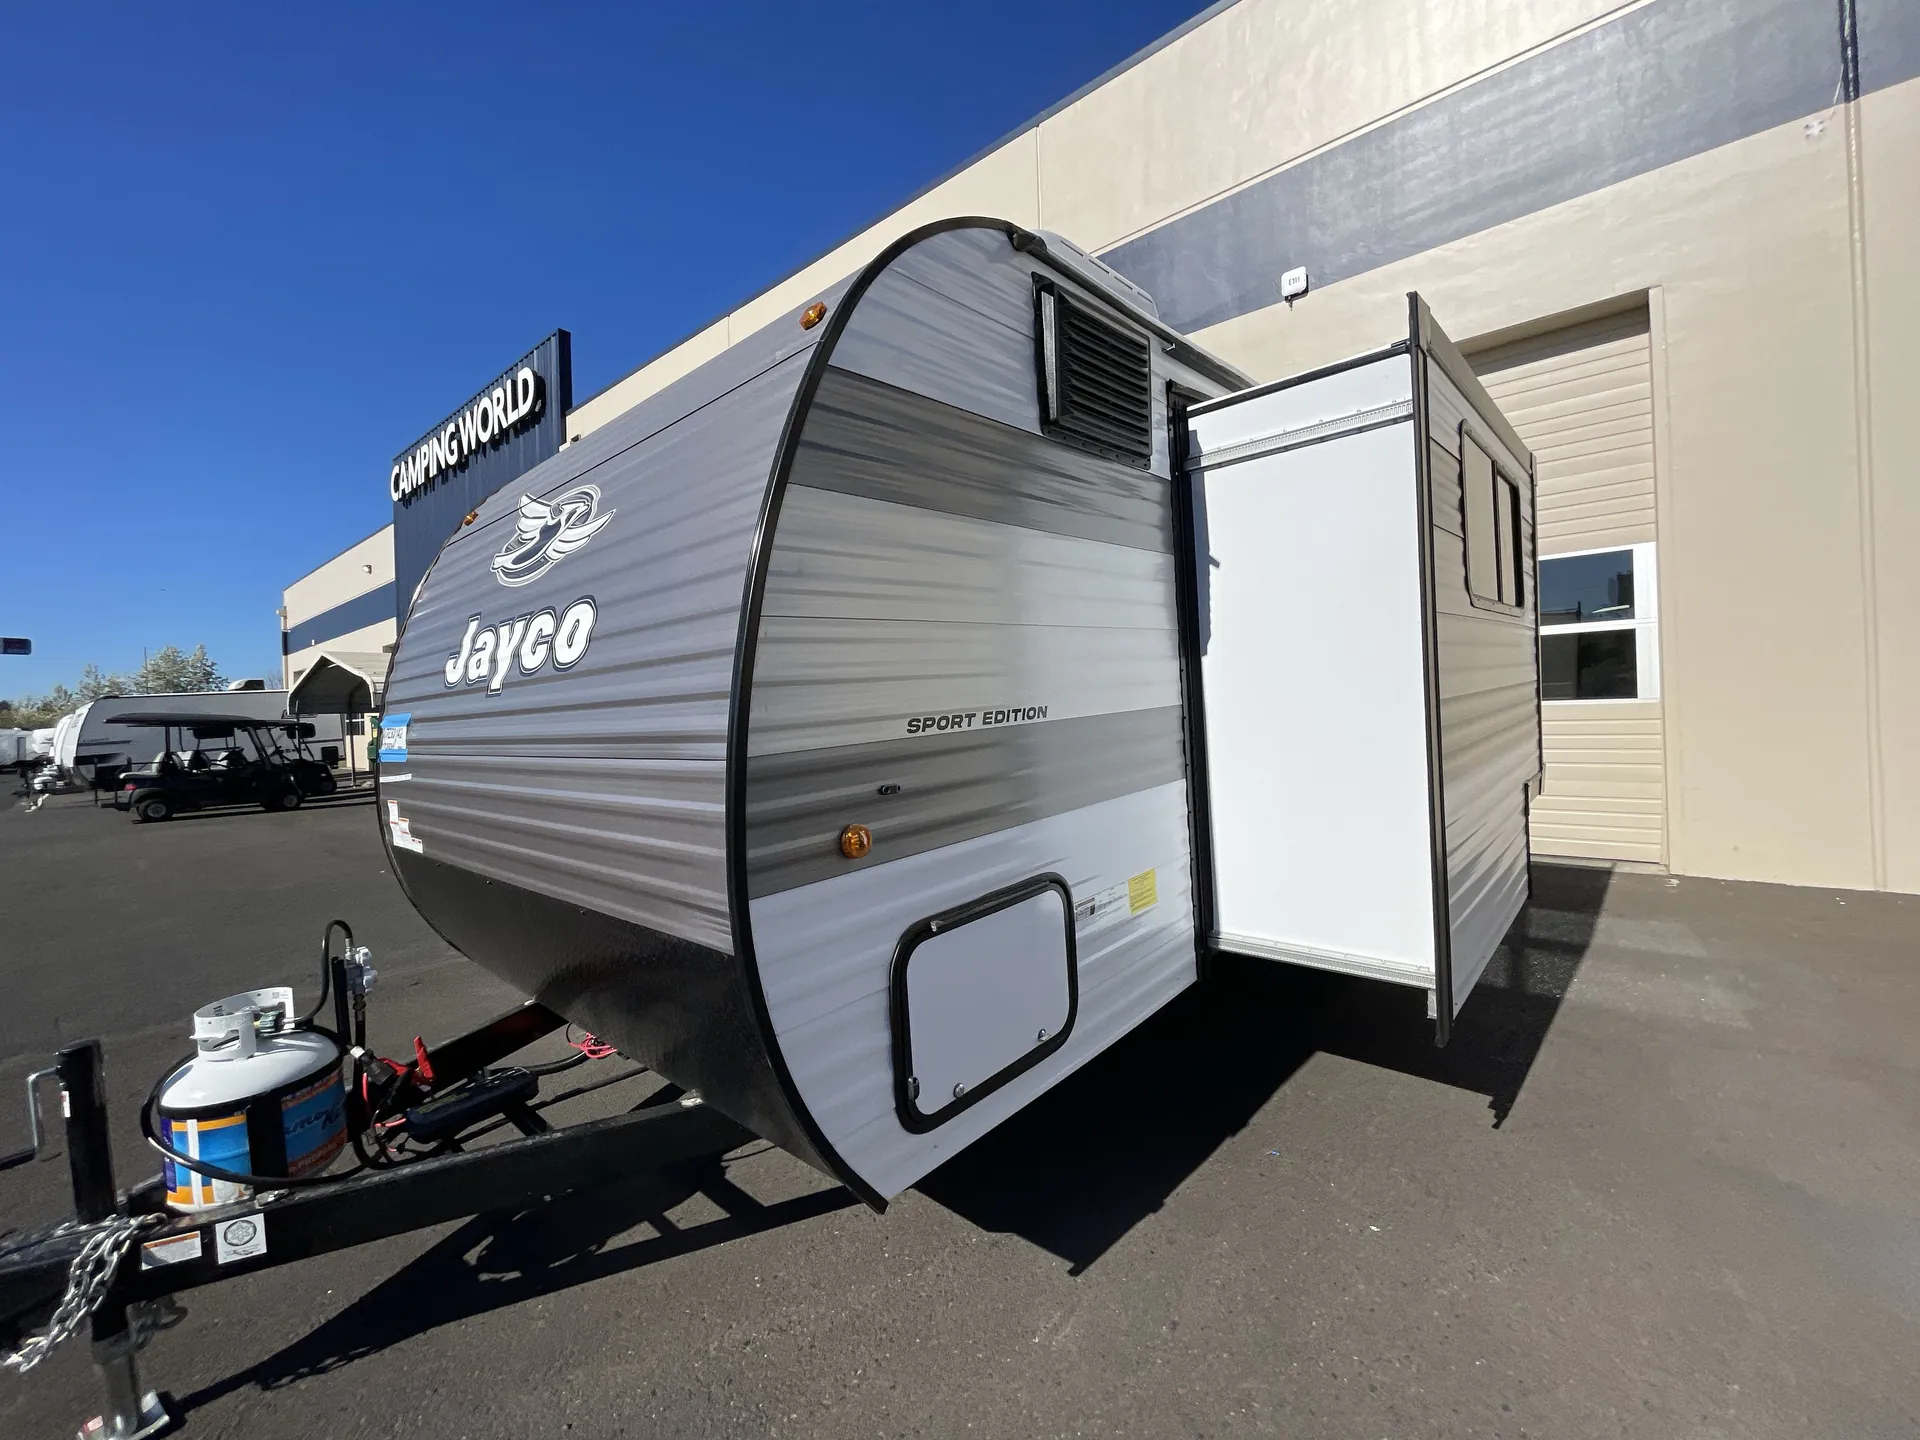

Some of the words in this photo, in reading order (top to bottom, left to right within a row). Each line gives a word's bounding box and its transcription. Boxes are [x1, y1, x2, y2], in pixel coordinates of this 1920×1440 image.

[391, 423, 458, 501] CAMPING
[459, 367, 535, 455] WORLD
[444, 597, 597, 696] Jayco
[906, 713, 976, 734] SPORT
[982, 705, 1048, 726] EDITION
